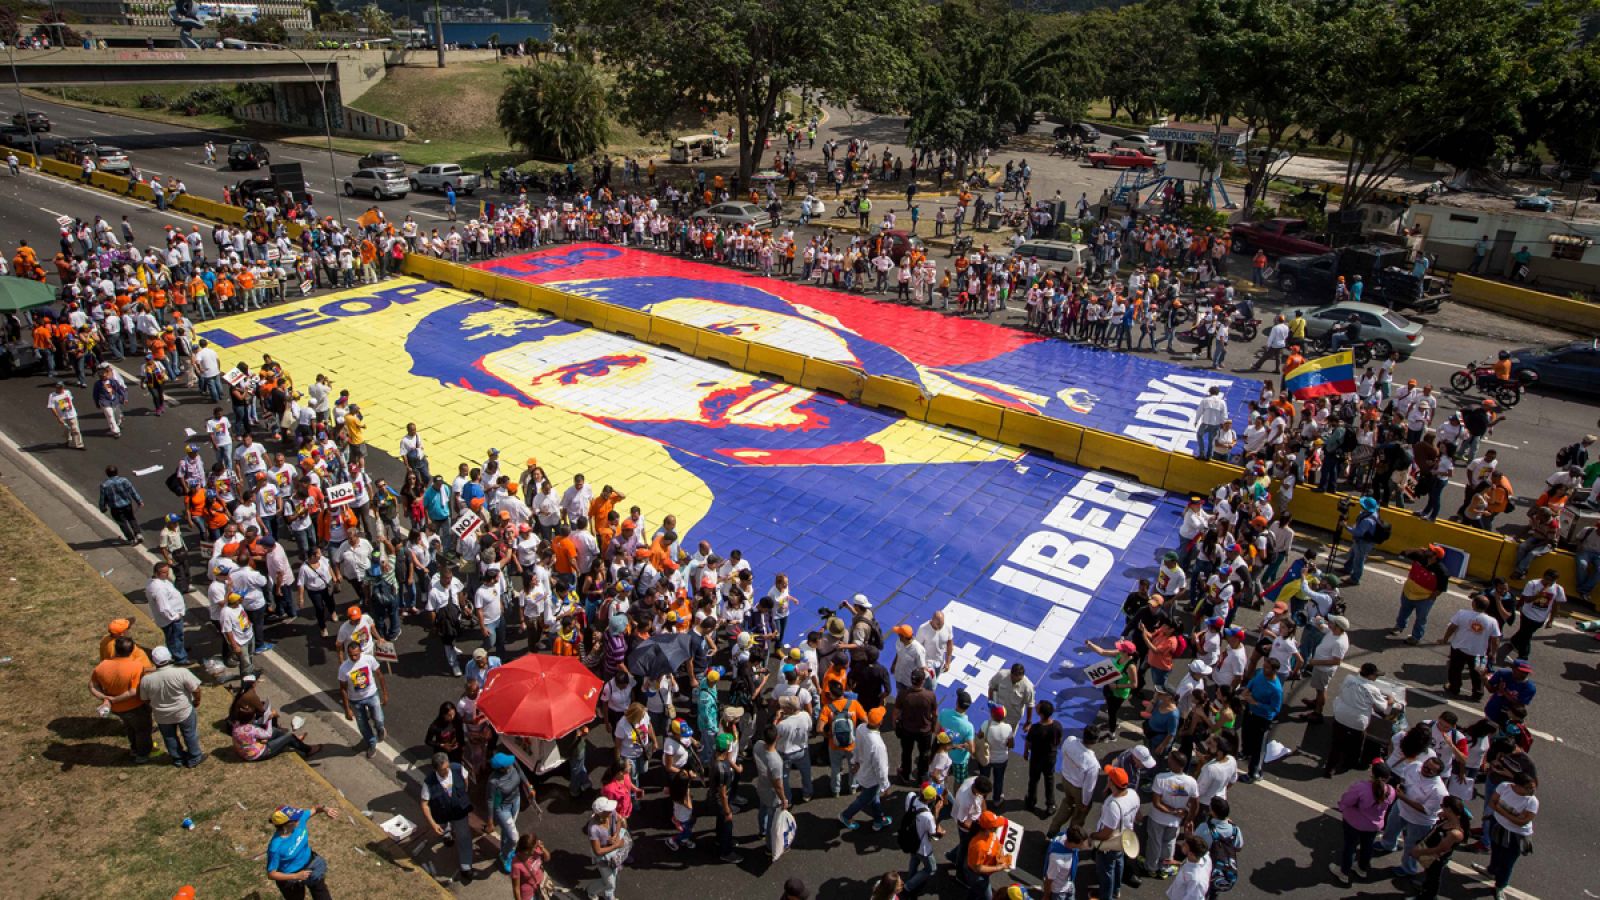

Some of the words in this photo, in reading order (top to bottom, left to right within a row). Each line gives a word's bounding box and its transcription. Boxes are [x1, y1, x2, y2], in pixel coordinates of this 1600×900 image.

[197, 282, 446, 348] LEOP
[331, 487, 352, 499] NO+
[455, 515, 475, 534] NO+
[1088, 665, 1113, 680] NO+
